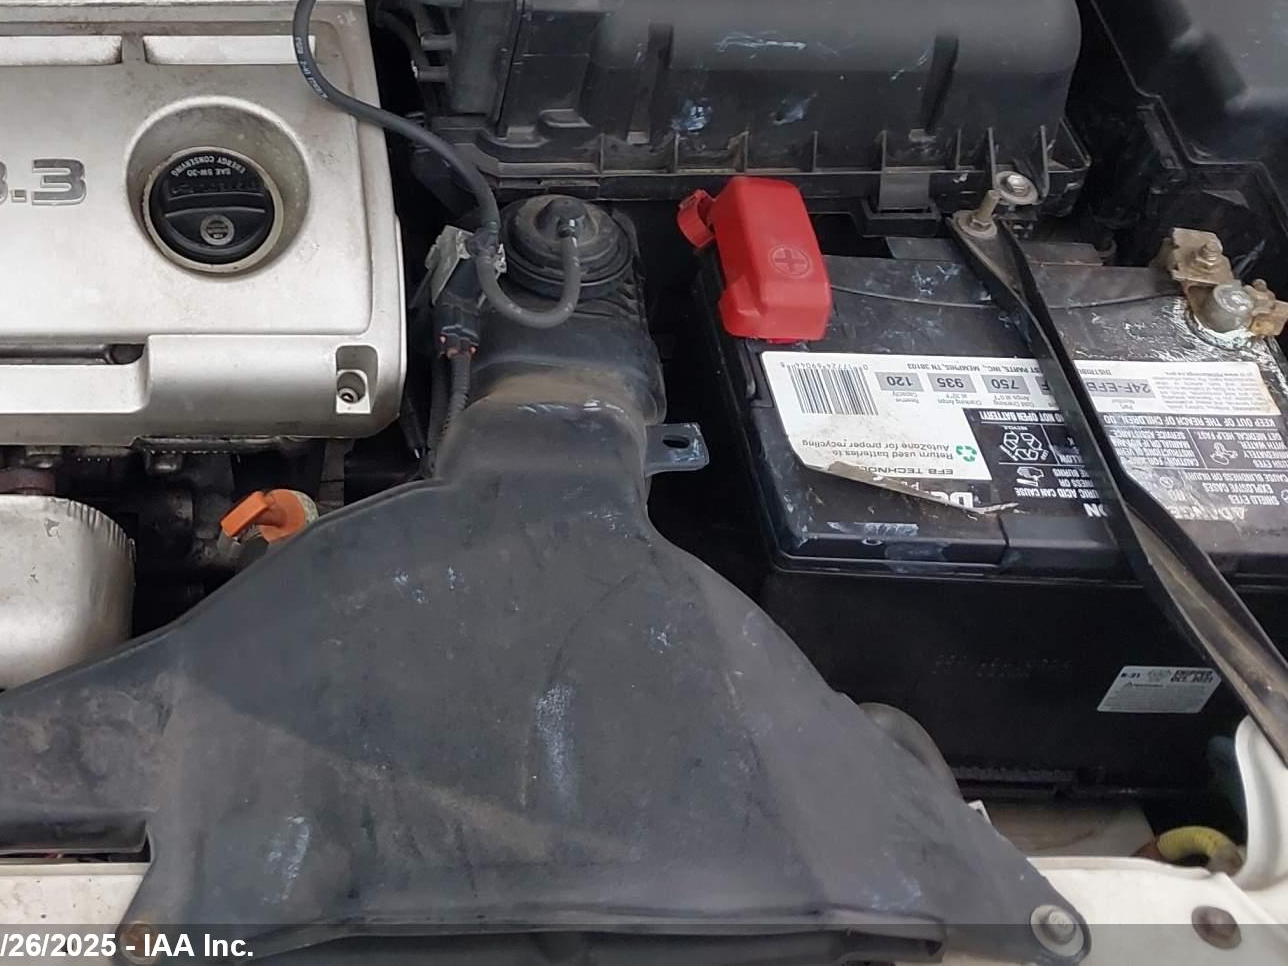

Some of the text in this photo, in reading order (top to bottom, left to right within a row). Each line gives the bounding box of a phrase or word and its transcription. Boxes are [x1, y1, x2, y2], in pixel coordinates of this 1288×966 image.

[886, 376, 913, 387] 120
[936, 377, 964, 389] 935
[991, 378, 1019, 390] 750
[1016, 411, 1039, 422] OPEN
[1038, 412, 1056, 423] NOT
[1163, 416, 1176, 426] OF
[1175, 416, 1205, 426] REACH
[1204, 417, 1223, 427] THE
[1223, 417, 1237, 427] OF
[1236, 417, 1254, 427] OUT
[1253, 417, 1276, 427] KEEP
[802, 439, 847, 450] recycling
[891, 450, 917, 460] used
[919, 451, 953, 460] Return
[927, 467, 953, 475] EFB
[1014, 487, 1041, 497] CAUSE
[1040, 488, 1057, 498] CAN
[1056, 488, 1078, 499] ACID
[1228, 494, 1251, 505] EYES
